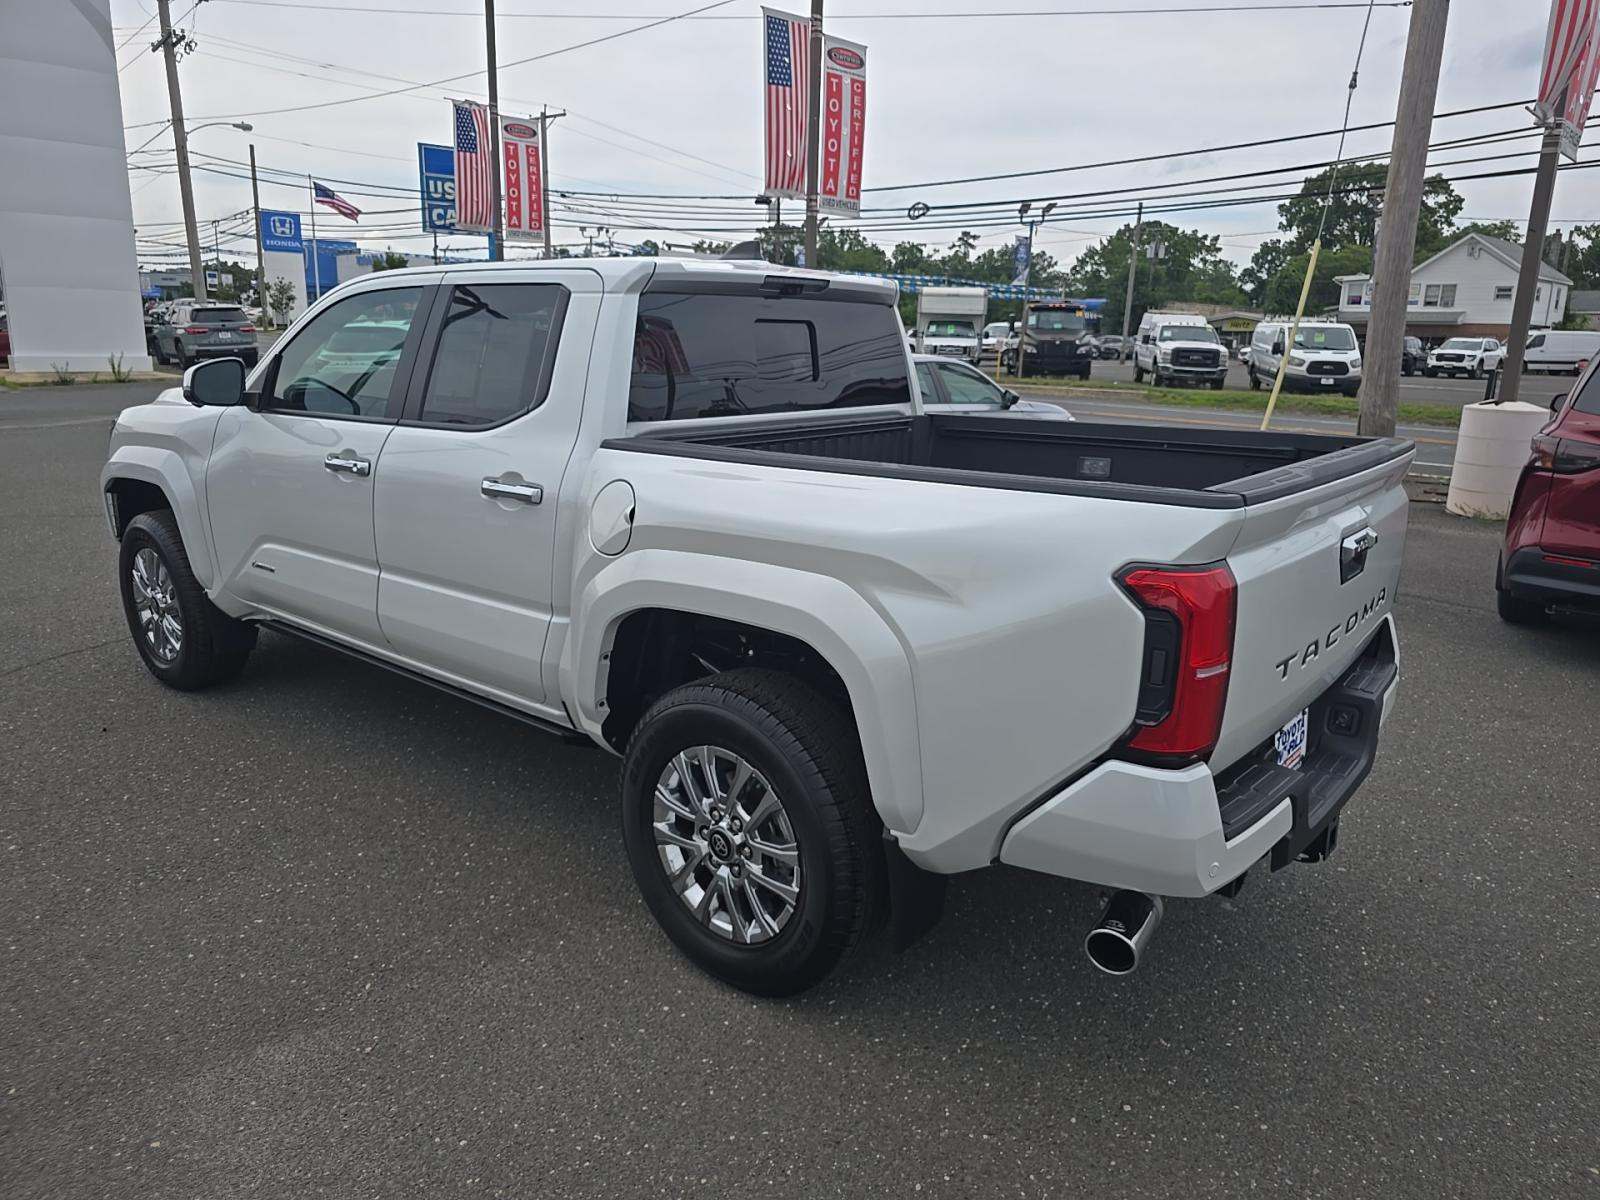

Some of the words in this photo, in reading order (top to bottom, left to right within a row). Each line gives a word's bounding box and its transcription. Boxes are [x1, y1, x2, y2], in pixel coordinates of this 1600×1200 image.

[825, 77, 839, 192] TOYOTA
[848, 82, 862, 197] CERTIFIED
[429, 180, 456, 200] US
[507, 145, 519, 226] TOYOTA
[528, 147, 540, 229] CERTIFIED
[266, 240, 302, 248] HONDA
[1275, 587, 1386, 680] TACOMA
[1277, 718, 1304, 750] TOYOTA
